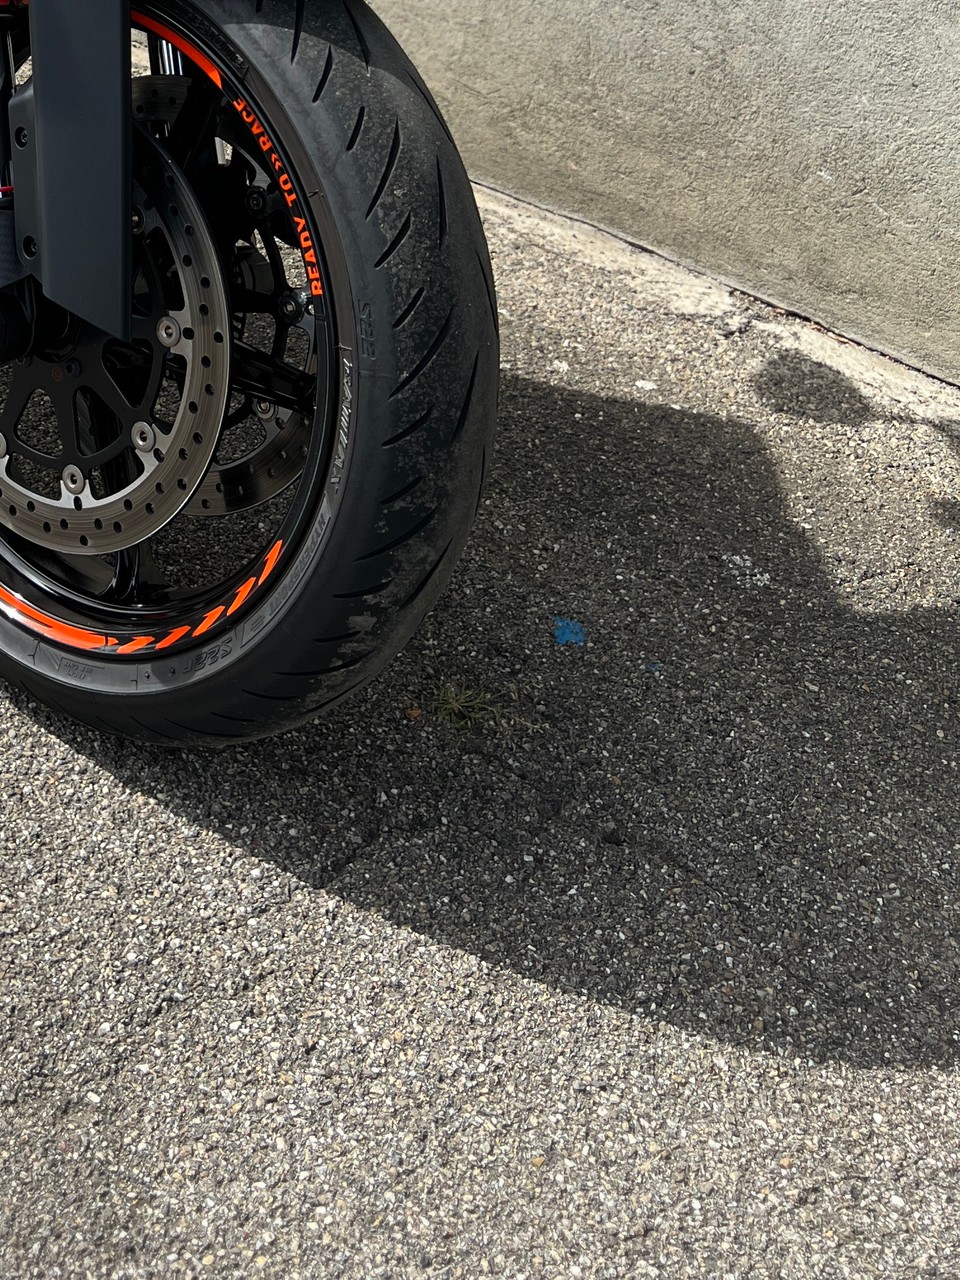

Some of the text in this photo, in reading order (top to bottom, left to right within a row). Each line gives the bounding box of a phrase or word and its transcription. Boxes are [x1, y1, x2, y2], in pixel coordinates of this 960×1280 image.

[233, 98, 323, 296] READY TO RACE
[268, 512, 328, 616] HYPERSPORT
